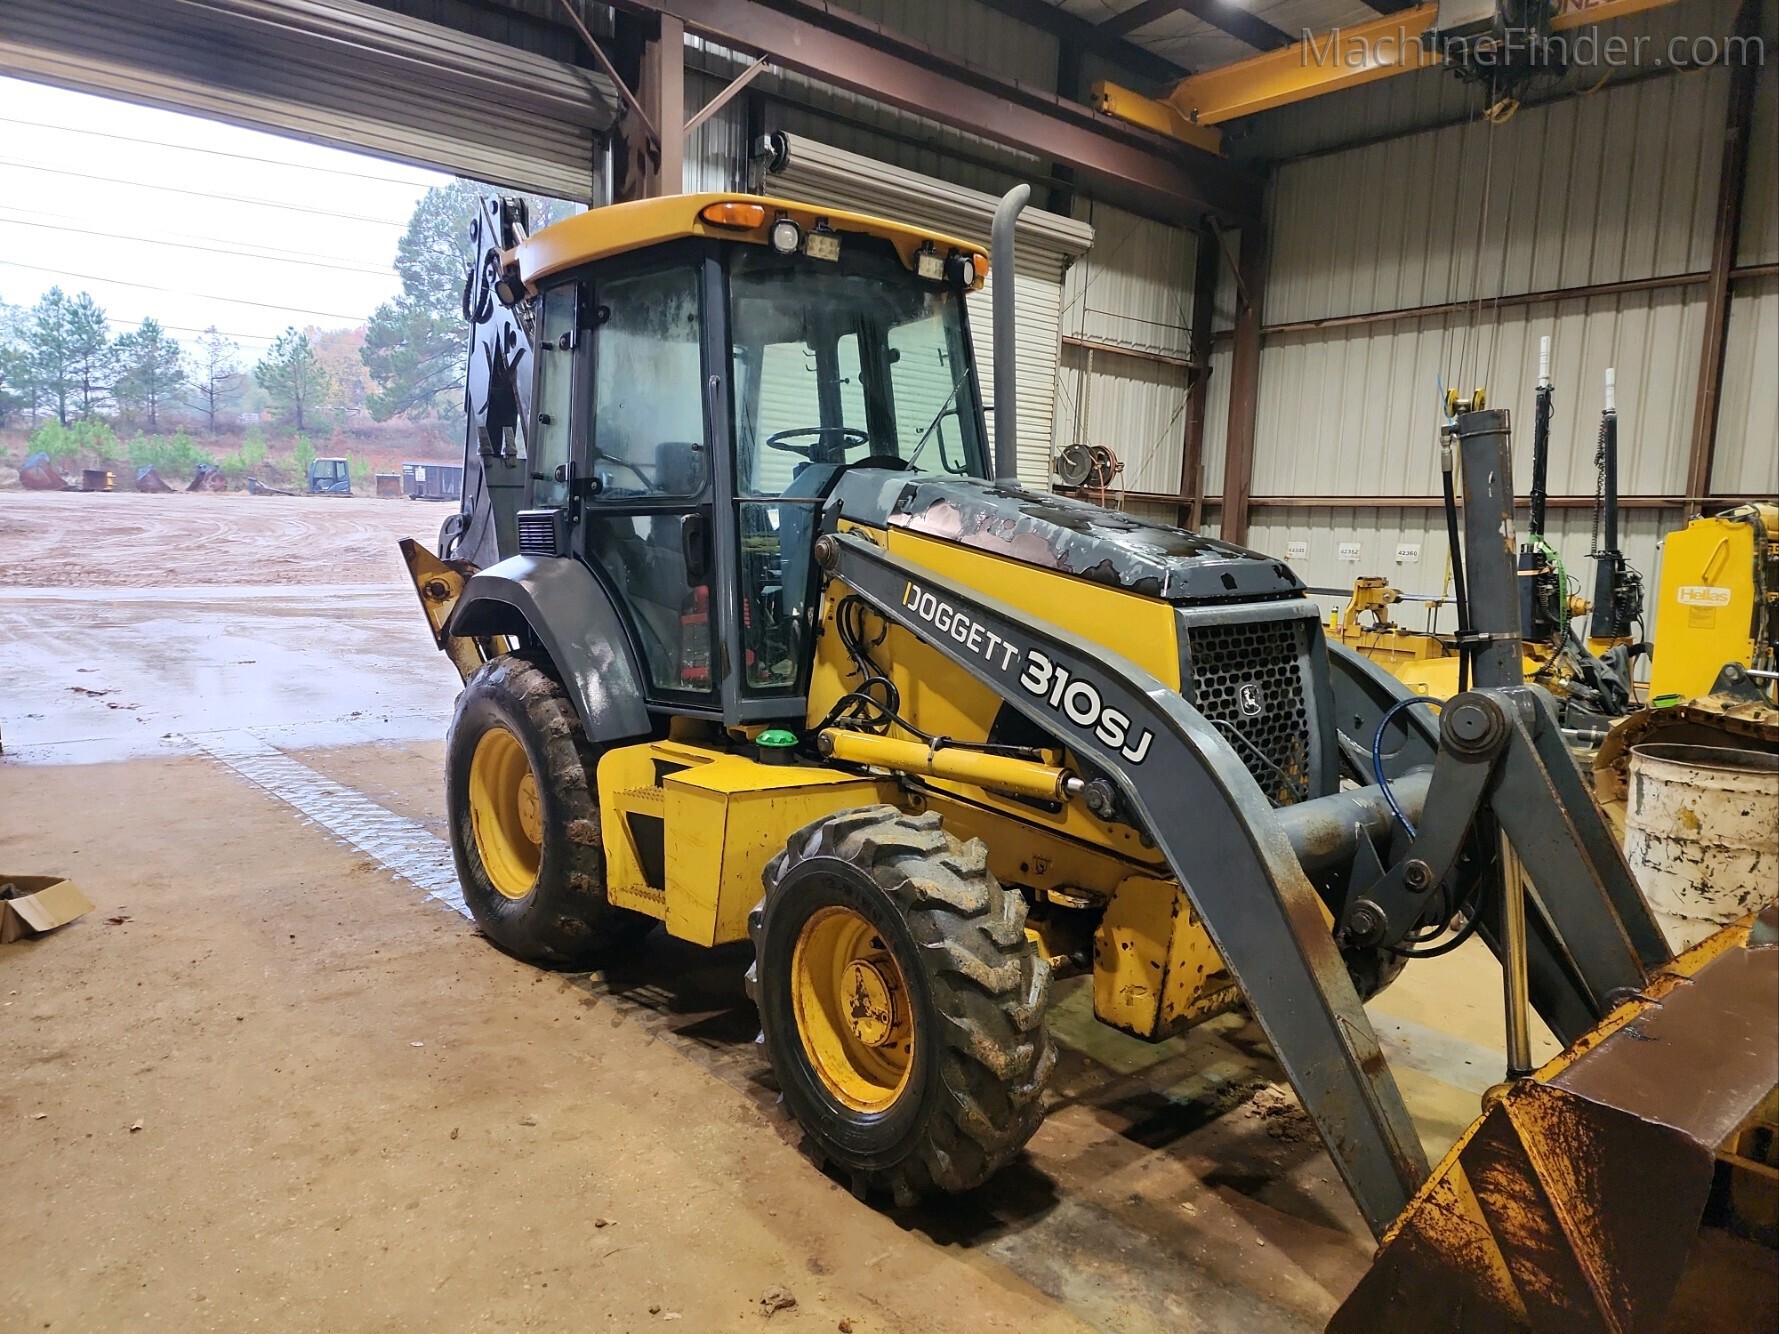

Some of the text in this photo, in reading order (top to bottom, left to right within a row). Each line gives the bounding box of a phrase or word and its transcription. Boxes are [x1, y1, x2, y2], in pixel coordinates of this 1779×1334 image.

[1680, 588, 1729, 602] Hellas
[902, 581, 1155, 764] DOGGETT 310SJ
